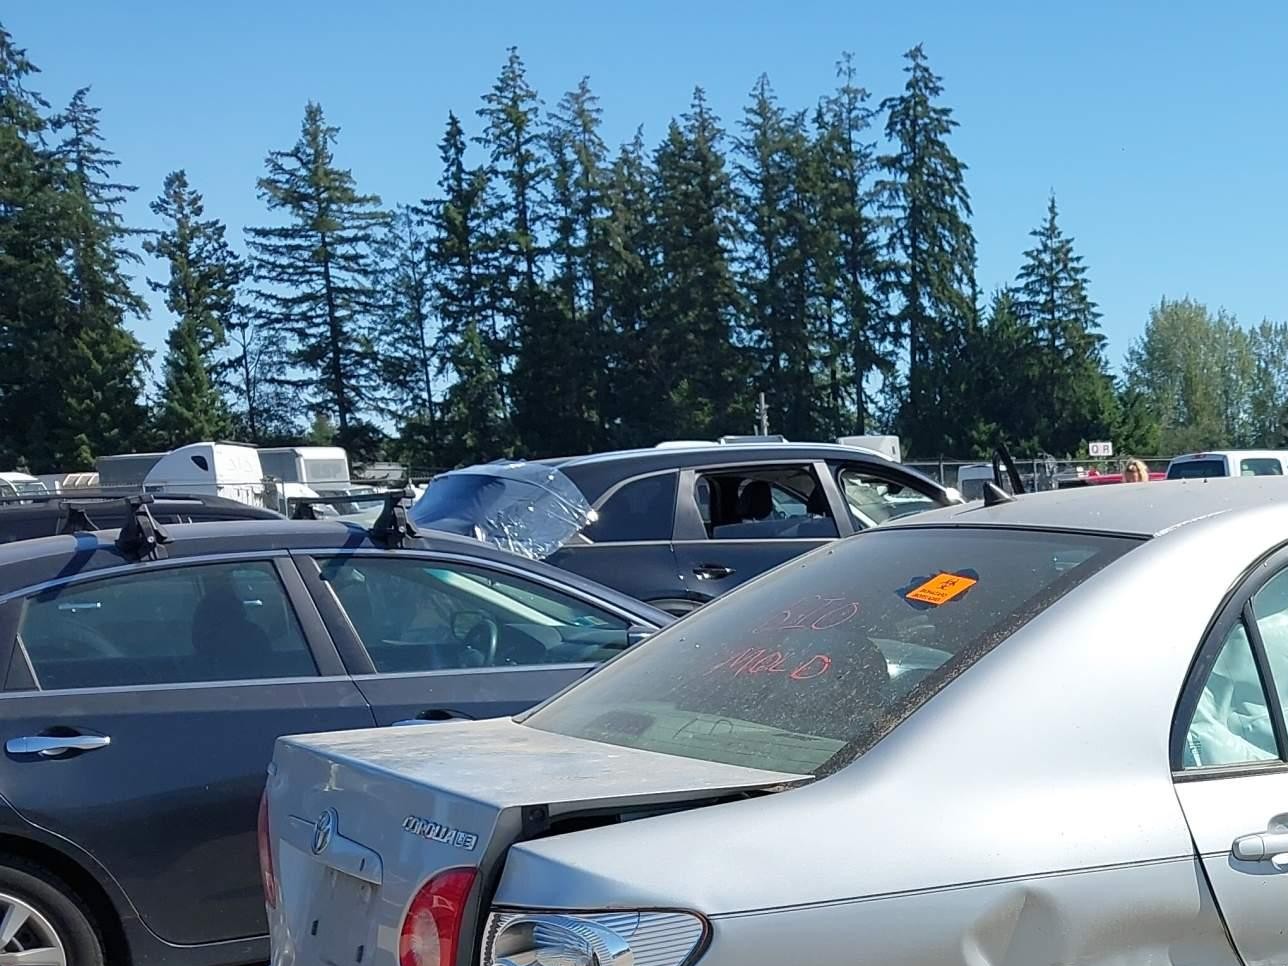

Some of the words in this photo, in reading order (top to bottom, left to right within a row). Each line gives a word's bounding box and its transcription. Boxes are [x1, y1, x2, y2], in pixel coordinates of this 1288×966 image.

[702, 648, 832, 680] MOLD
[402, 816, 457, 846] COROLLA
[455, 831, 477, 850] LE
